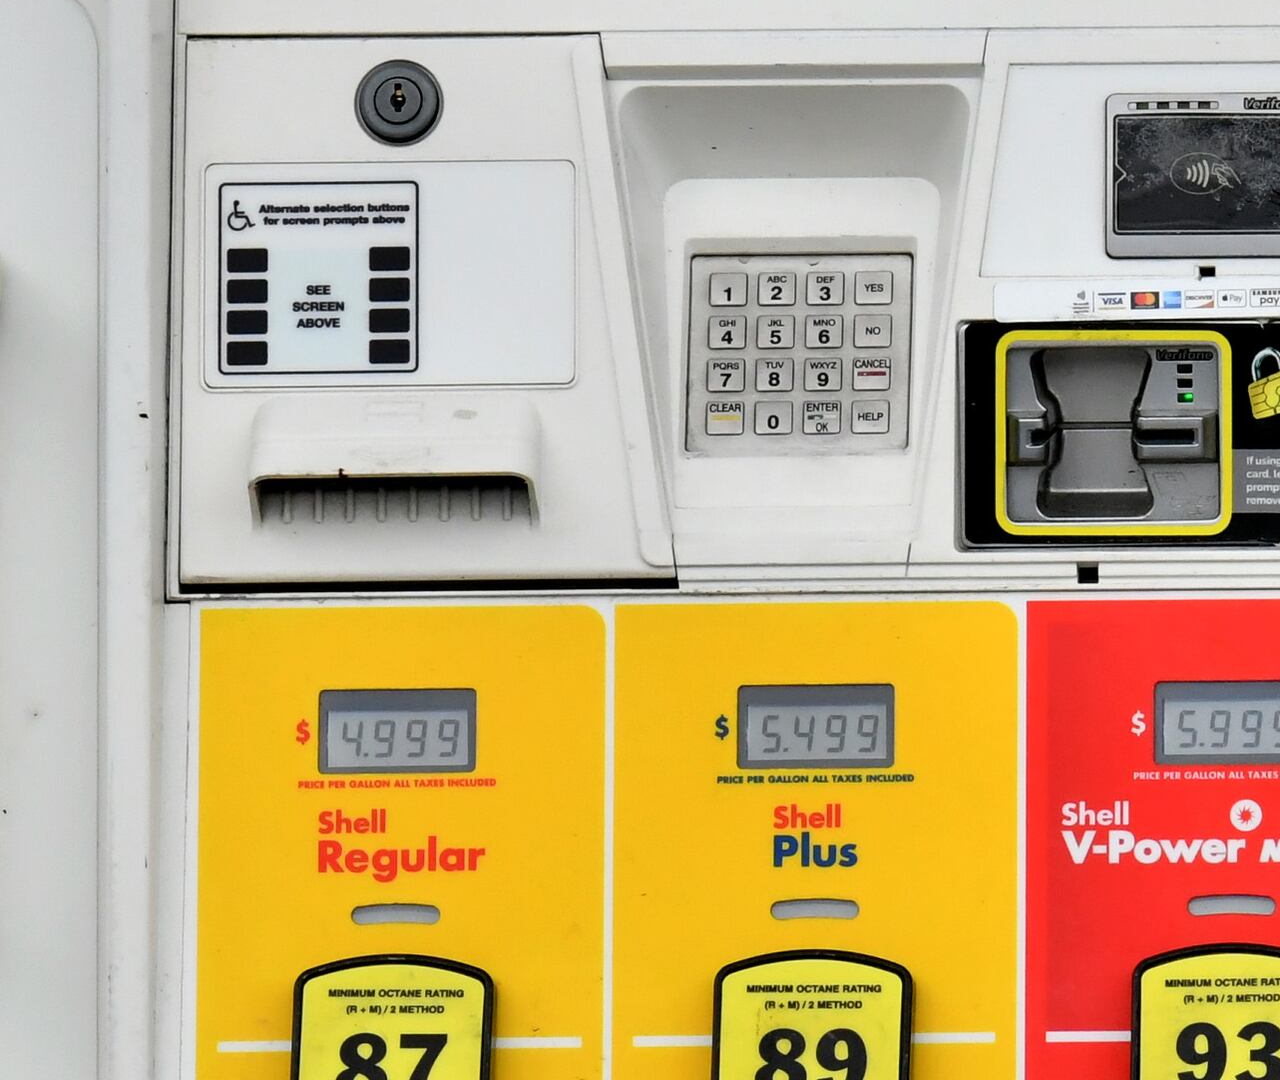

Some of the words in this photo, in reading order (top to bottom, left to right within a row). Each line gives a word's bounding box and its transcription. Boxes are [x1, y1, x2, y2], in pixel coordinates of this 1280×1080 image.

[306, 285, 330, 295] SEE
[724, 287, 732, 301] 1
[771, 286, 782, 300] 2
[819, 287, 831, 300] 3
[864, 284, 884, 292] YES
[293, 302, 344, 312] SCREEN
[297, 318, 340, 328] ABOVE
[721, 331, 733, 344] 4
[770, 331, 781, 344] 5
[818, 330, 830, 343] 6
[866, 327, 880, 335] NO
[854, 360, 891, 368] CANCEL
[720, 374, 732, 387] 7
[769, 373, 780, 386] 8
[817, 373, 828, 386] 9
[710, 404, 741, 412] CLEAR
[806, 403, 838, 412] ENTER
[768, 416, 779, 429] 0
[858, 413, 883, 421] HELP
[816, 423, 828, 432] OK
[1131, 710, 1146, 736] $
[296, 719, 310, 745] $
[342, 719, 460, 757] 4.999
[715, 715, 729, 739] $
[762, 714, 880, 753] 5.499
[773, 804, 841, 829] Shell
[1062, 801, 1129, 826] Shell
[318, 809, 386, 834] Shell
[773, 832, 857, 867] Plus
[1061, 830, 1246, 865] V-Power
[318, 836, 485, 882] Regular
[329, 989, 375, 997] MINIMUM
[378, 989, 421, 997] OCTANE
[335, 1032, 448, 1080] 87
[754, 1027, 868, 1080] 89
